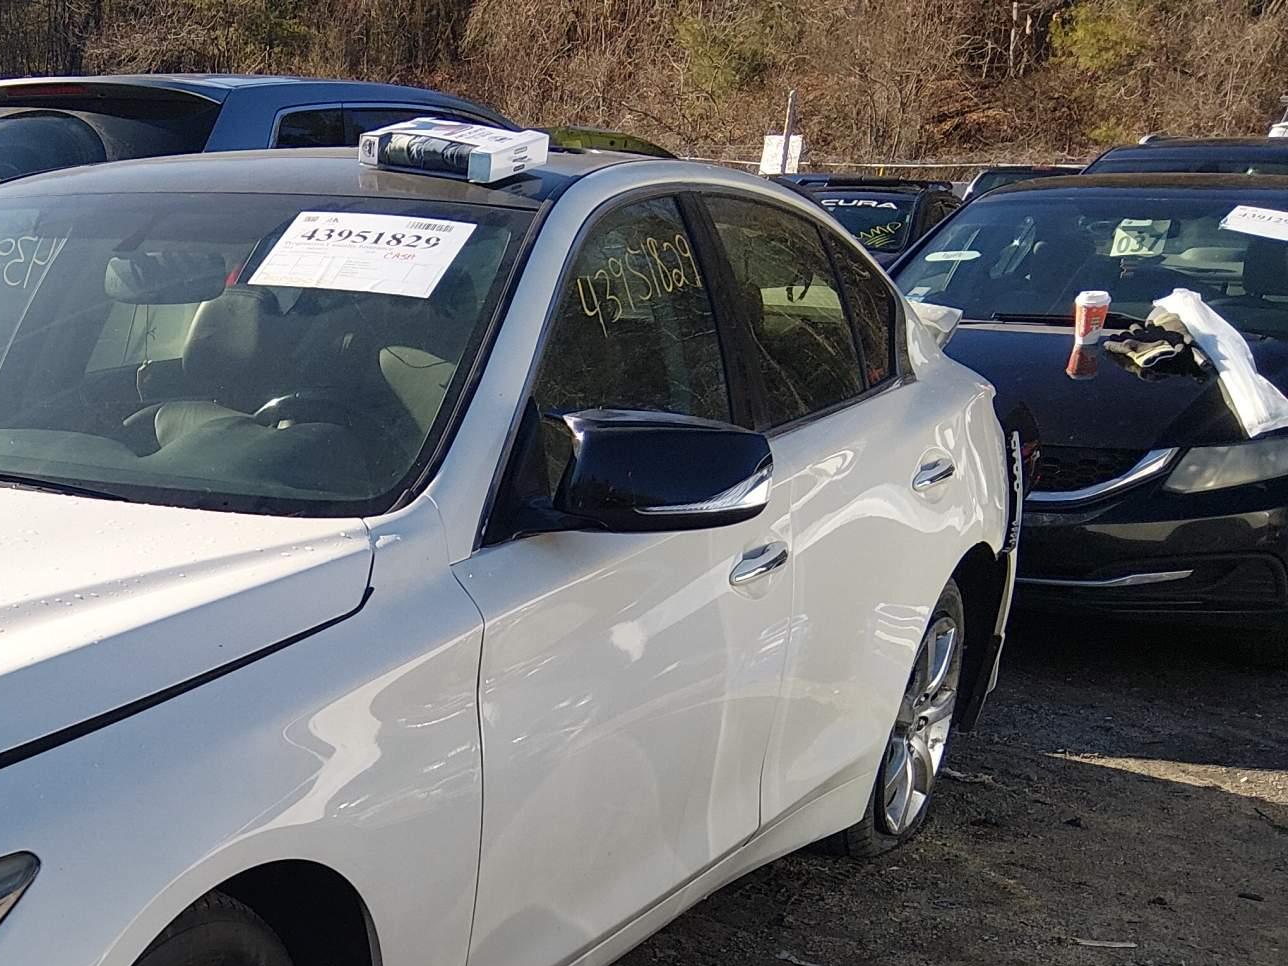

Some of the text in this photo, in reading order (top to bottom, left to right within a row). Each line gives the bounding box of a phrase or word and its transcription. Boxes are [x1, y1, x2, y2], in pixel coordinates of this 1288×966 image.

[821, 199, 898, 210] CURA
[300, 227, 442, 250] 43951829
[577, 233, 703, 338] 43951829
